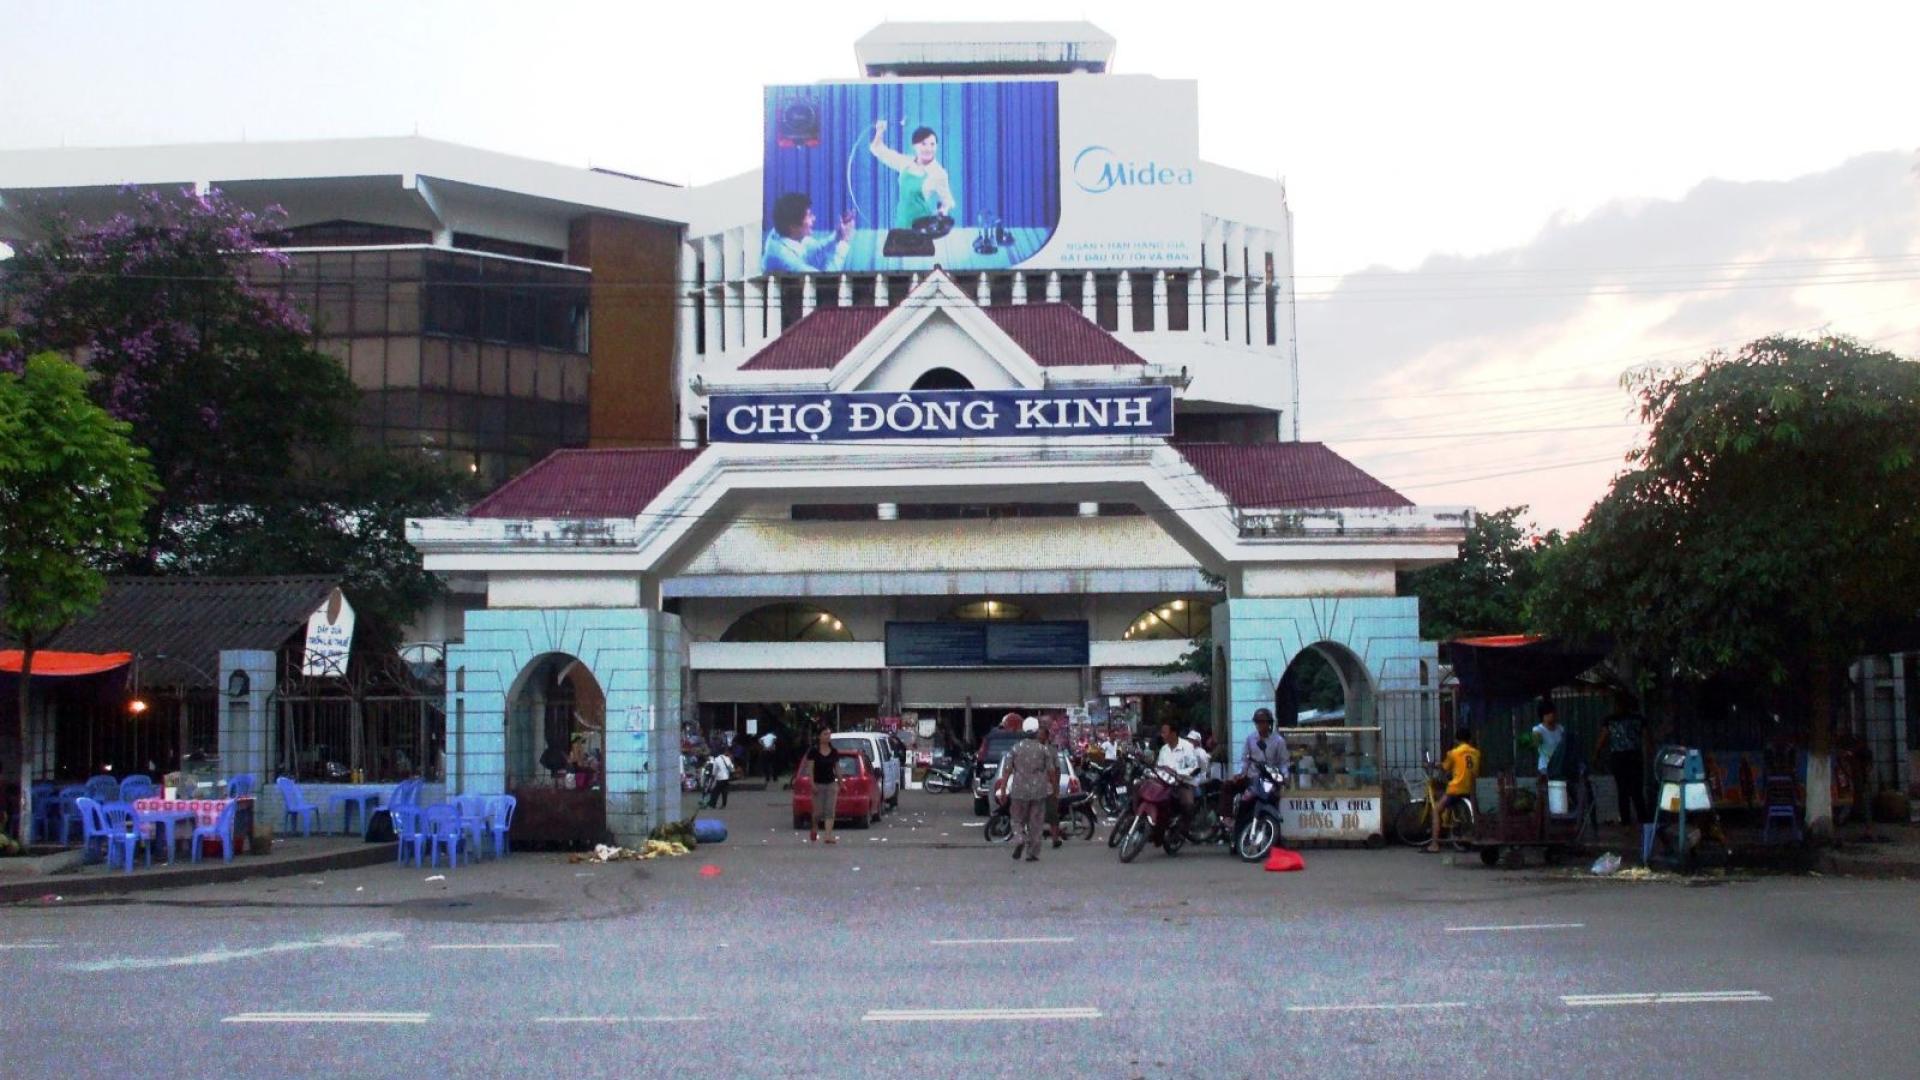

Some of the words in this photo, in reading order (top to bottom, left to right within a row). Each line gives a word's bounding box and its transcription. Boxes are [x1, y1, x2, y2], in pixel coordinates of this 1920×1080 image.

[1096, 161, 1193, 187] Midea
[726, 400, 832, 440] CHỢ
[848, 394, 998, 431] ĐÔNG
[1014, 397, 1152, 429] KINH
